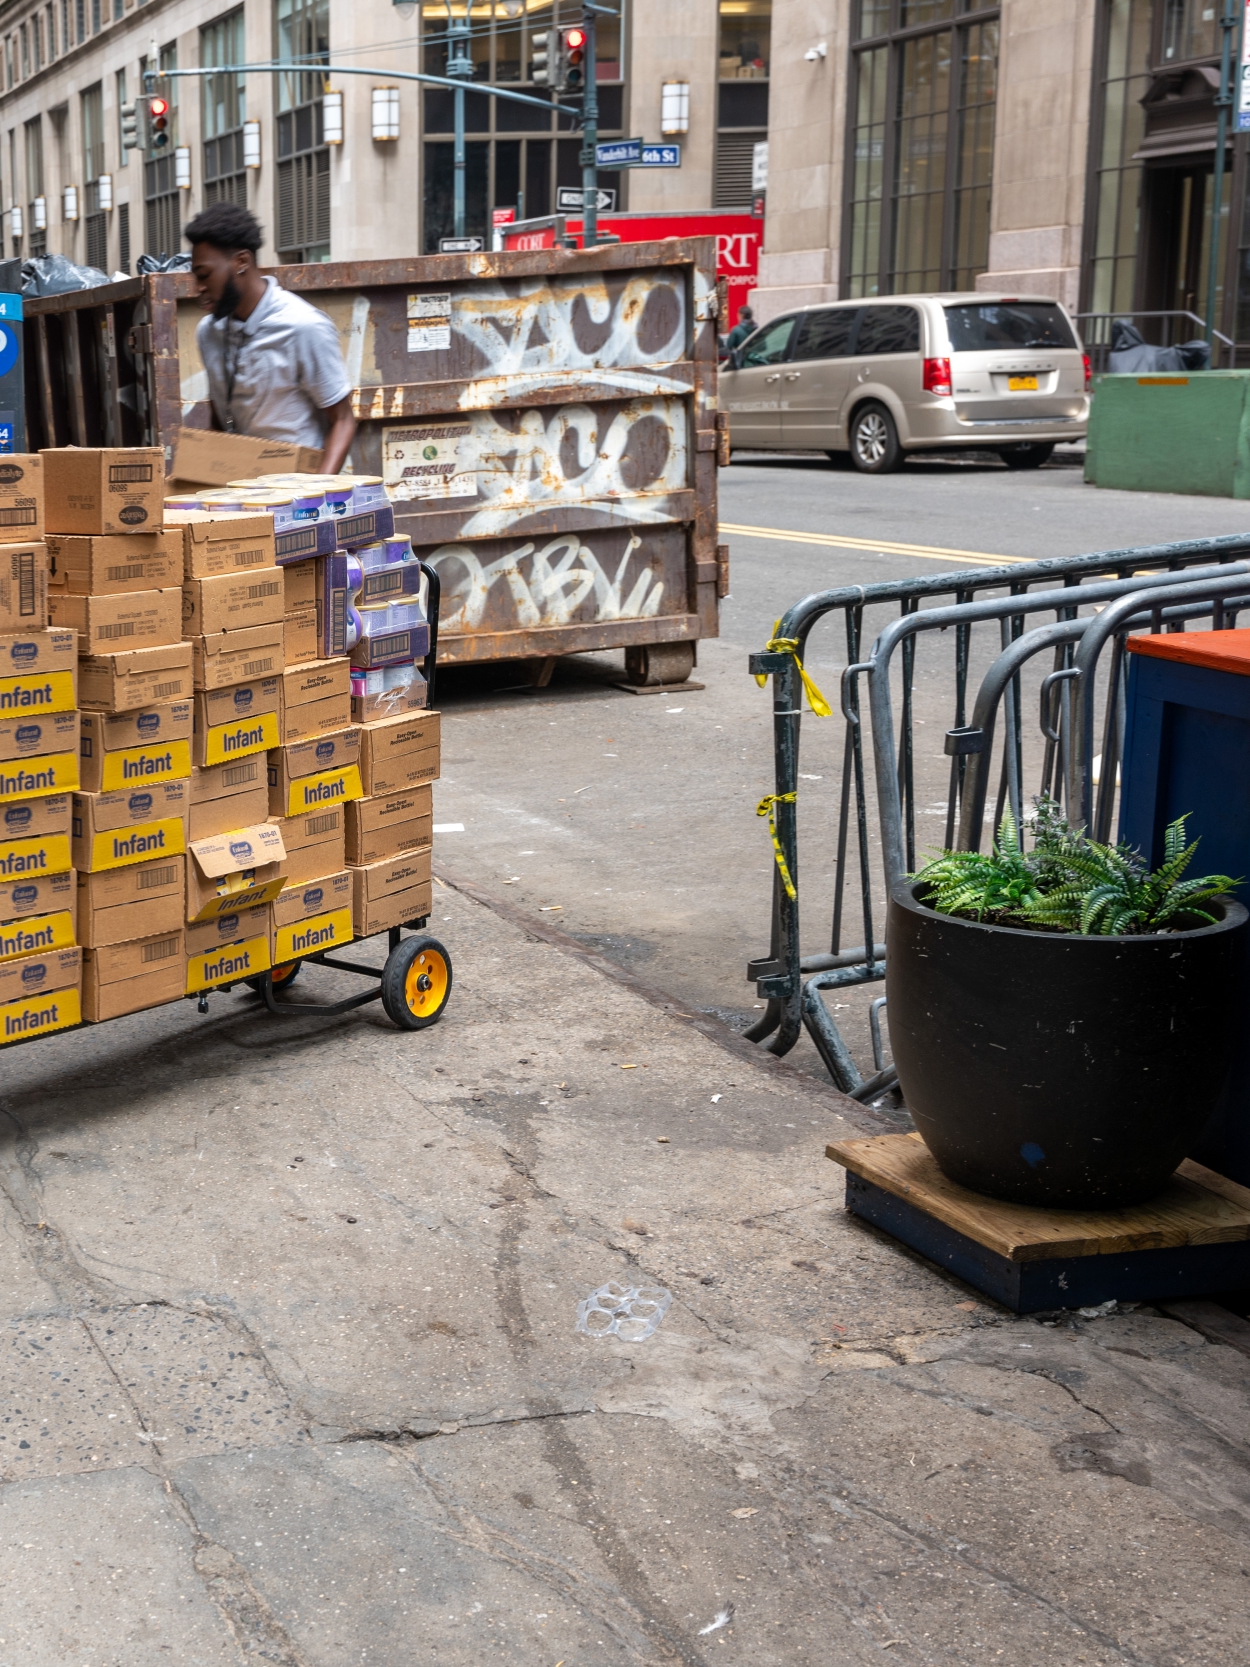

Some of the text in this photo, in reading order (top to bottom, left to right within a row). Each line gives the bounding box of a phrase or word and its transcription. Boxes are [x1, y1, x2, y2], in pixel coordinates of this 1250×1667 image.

[597, 146, 640, 161] Vanderbilt Ave
[642, 150, 675, 162] 6th St
[716, 233, 759, 268] RT
[726, 275, 757, 286] CORPO
[401, 463, 456, 478] RECYCLING
[109, 483, 128, 493] 56090
[14, 498, 37, 507] 56090
[120, 511, 146, 520] Pedialyte
[295, 511, 318, 519] Enfamil
[11, 553, 20, 581] 56090
[50, 634, 72, 643] 1870-01
[261, 679, 277, 688] 1870-01
[306, 675, 327, 684] Easy-Open
[407, 699, 423, 708] 55963
[171, 705, 189, 713] 1870-01
[54, 715, 75, 725] 1870-01
[223, 725, 264, 753] Infant
[343, 732, 359, 741] 1870-01
[396, 730, 417, 739] Easy-Open
[123, 752, 172, 779] Infant
[0, 768, 55, 795] Infant
[163, 784, 183, 793] 1870-01
[304, 778, 345, 804] Infant
[45, 797, 67, 806] 1870-01
[385, 799, 407, 809] Easy-Open
[258, 830, 277, 839] 1870-01
[113, 829, 165, 858] Infant
[391, 866, 411, 877] Easy-Open
[50, 876, 71, 884] 1870-01
[332, 876, 349, 885] 1870-01
[216, 887, 268, 912] Infant
[292, 923, 335, 952] Infant
[58, 950, 79, 962] 1870-01
[204, 951, 250, 981] Infant
[5, 1004, 59, 1036] Infant
